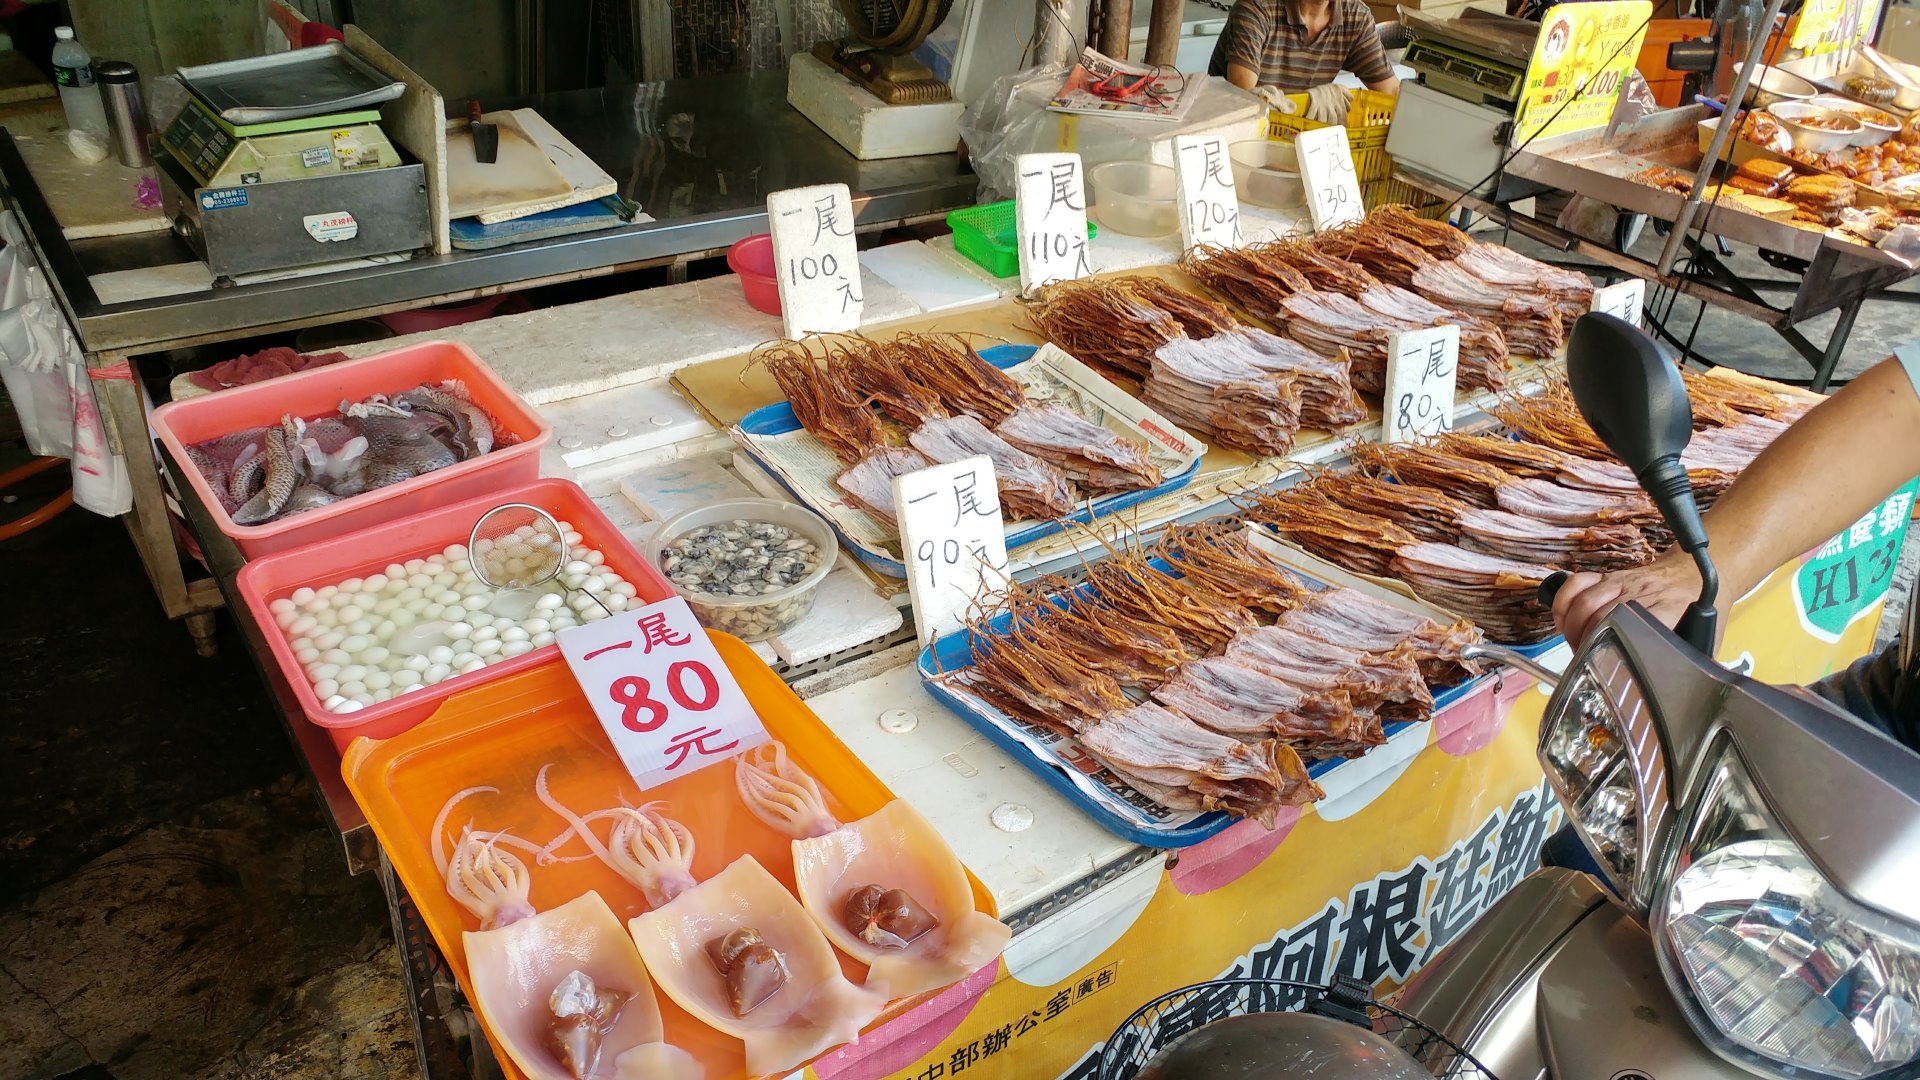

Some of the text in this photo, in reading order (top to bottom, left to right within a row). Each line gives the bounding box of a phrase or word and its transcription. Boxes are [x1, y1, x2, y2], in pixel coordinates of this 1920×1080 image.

[1181, 140, 1234, 191] 一尾
[1308, 134, 1355, 179] 一尾
[1022, 162, 1086, 221] 一尾
[782, 194, 855, 246] 一尾
[1402, 338, 1453, 386] 一尾
[908, 471, 1000, 528] 一尾
[1806, 539, 1896, 616] H13
[583, 612, 691, 661] 一尾
[609, 660, 720, 733] 80
[663, 726, 739, 771] 元
[906, 987, 1073, 1080] 中部辦公室
[1076, 968, 1113, 1000] 廣告
